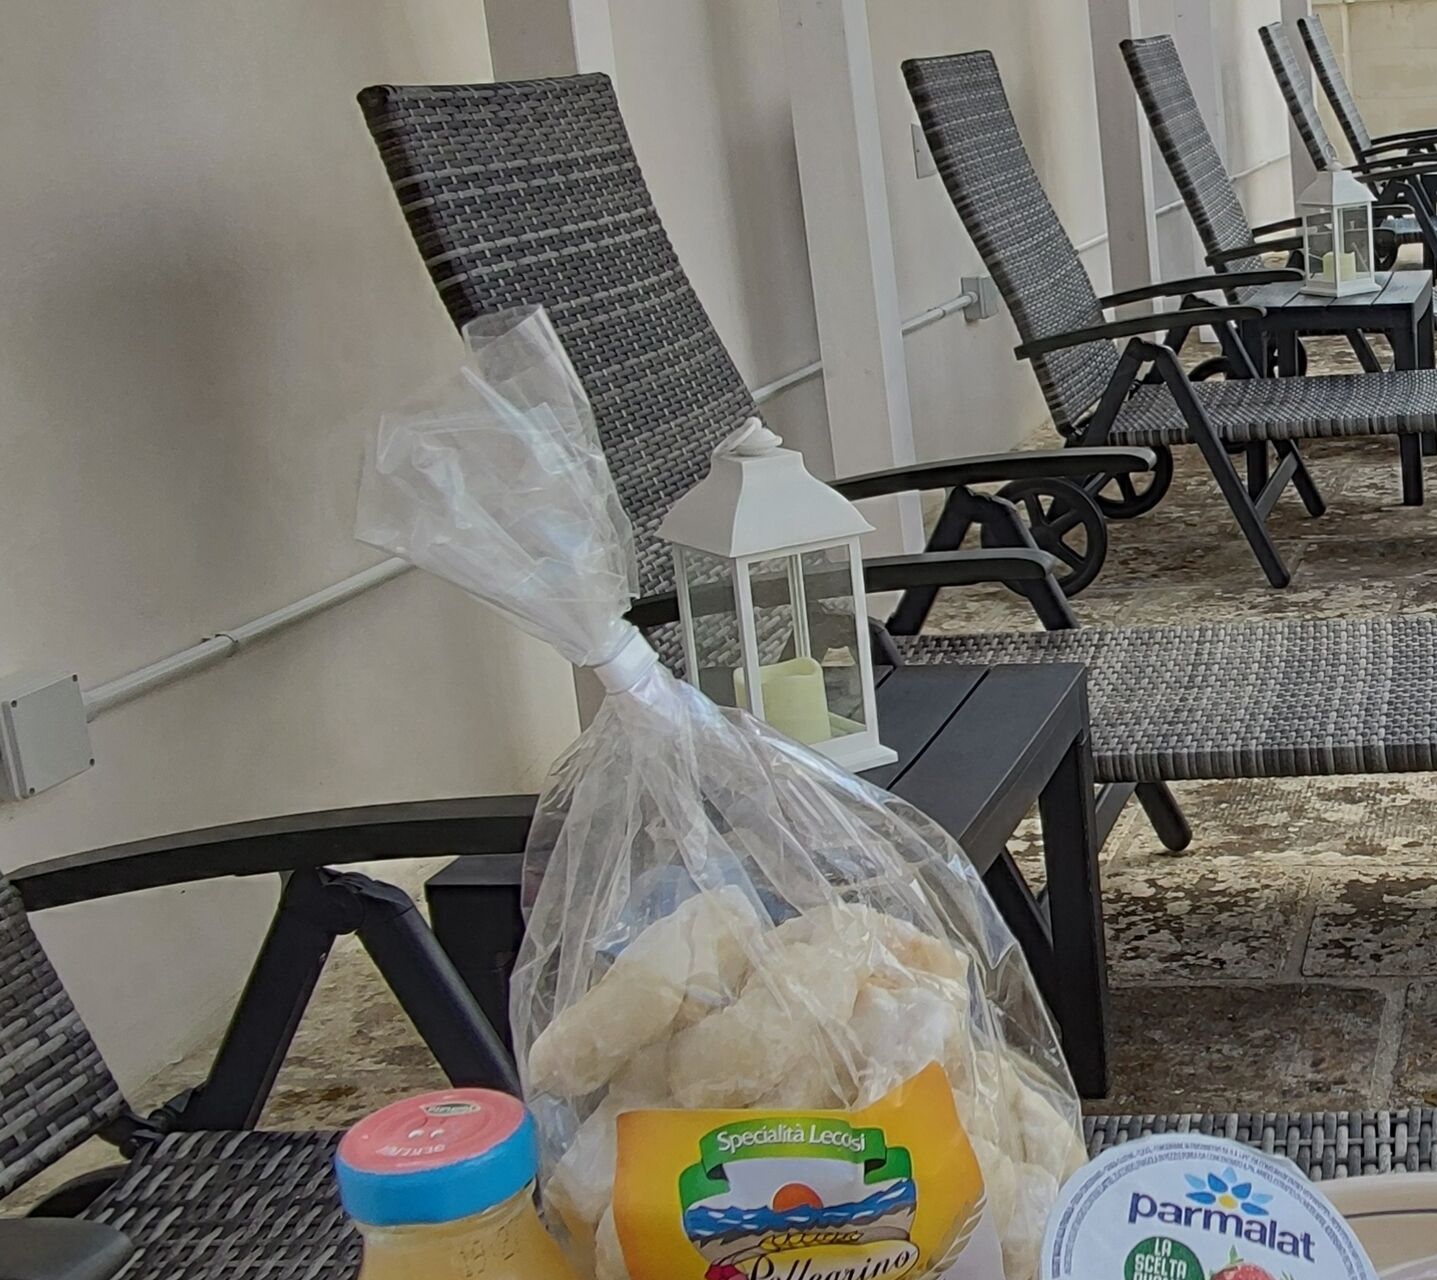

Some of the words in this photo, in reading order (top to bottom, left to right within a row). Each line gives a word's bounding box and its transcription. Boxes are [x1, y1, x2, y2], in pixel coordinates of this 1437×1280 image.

[717, 1124, 805, 1154] Specialità
[1127, 1191, 1316, 1263] parmalat
[1153, 1237, 1172, 1257] LA
[1134, 1254, 1187, 1279] SCELTA
